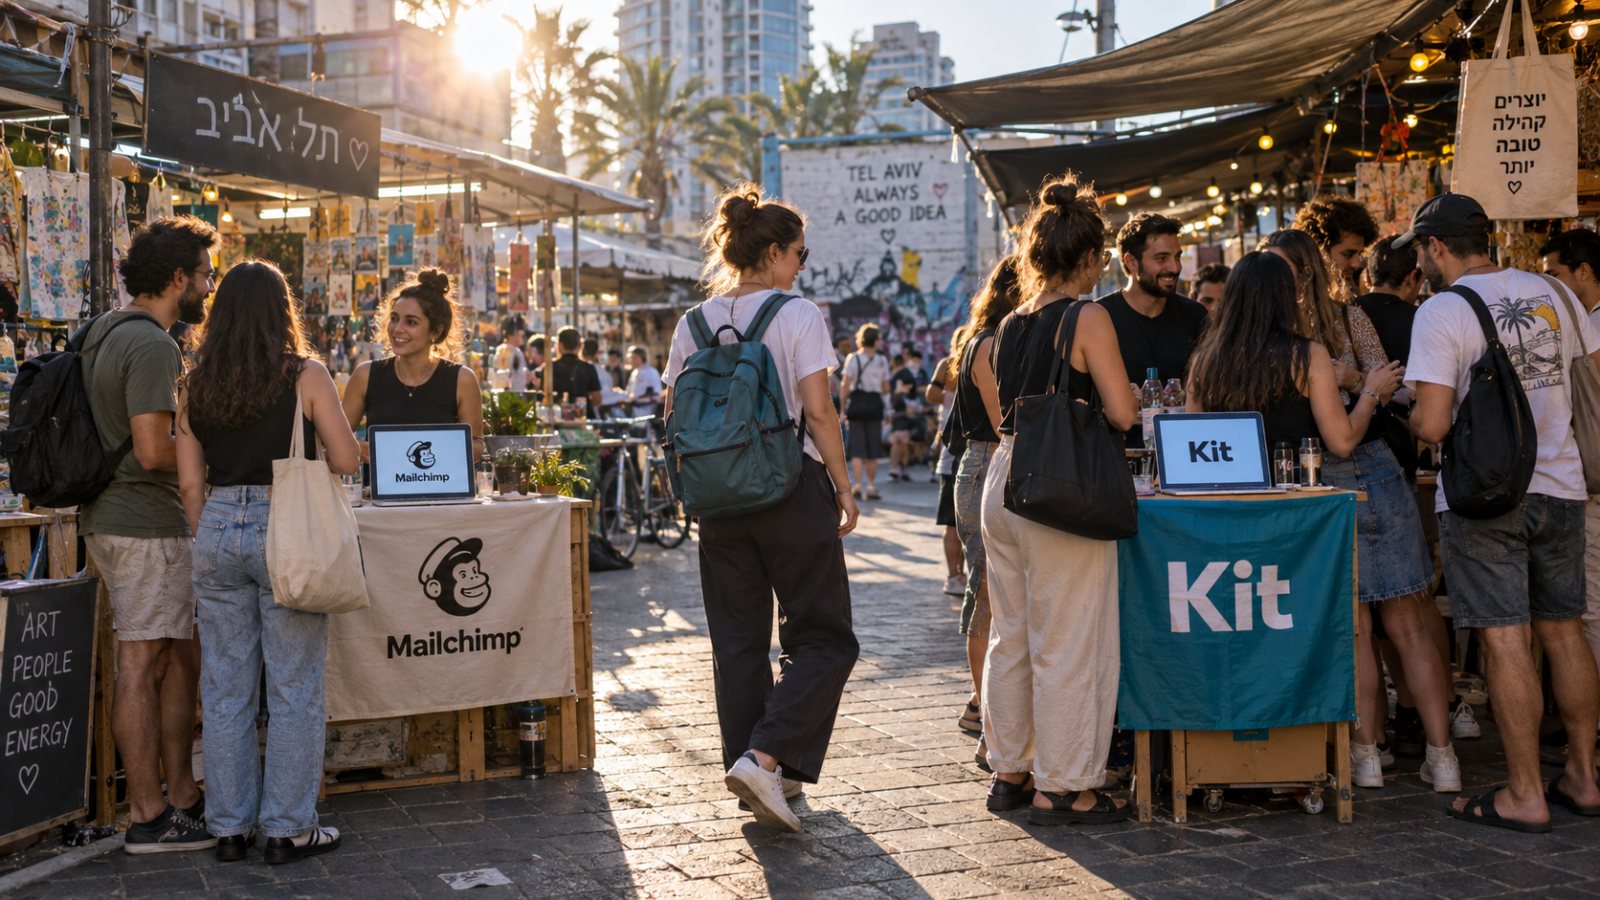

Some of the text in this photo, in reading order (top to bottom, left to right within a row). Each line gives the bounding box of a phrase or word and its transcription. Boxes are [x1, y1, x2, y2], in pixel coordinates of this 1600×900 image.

[1494, 93, 1546, 109] יוצרים
[195, 97, 339, 164] תל אביב
[1492, 114, 1546, 133] קהילה
[1496, 137, 1541, 153] טובה
[847, 161, 923, 182] TEL AVIV
[1499, 160, 1535, 174] יותר
[853, 184, 919, 204] ALWAYS
[834, 203, 947, 226] A GOOD IDEA
[1188, 440, 1234, 463] Kit
[395, 472, 450, 483] Mailchimp
[1167, 559, 1294, 633] Kit
[21, 610, 61, 642] ART
[387, 627, 522, 659] Mailchimp
[12, 650, 73, 682] PEOPLE
[9, 681, 58, 719] GOOD
